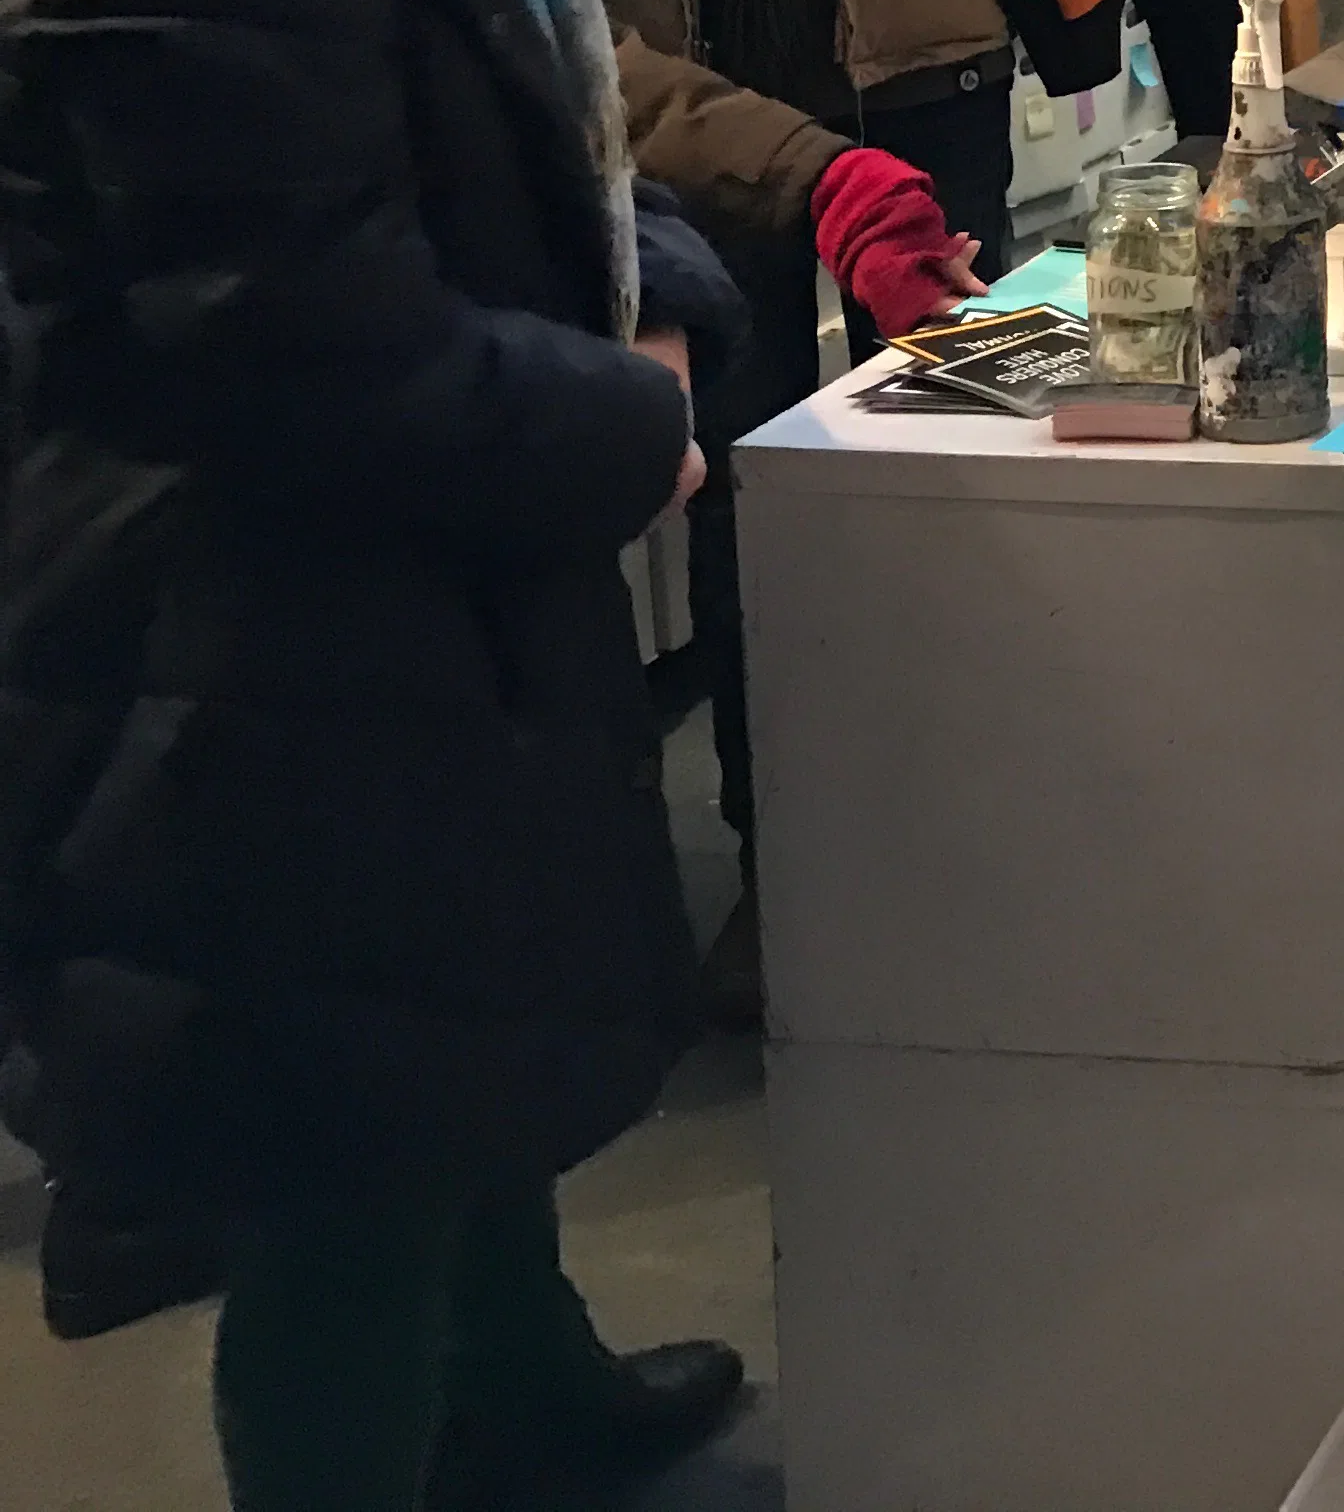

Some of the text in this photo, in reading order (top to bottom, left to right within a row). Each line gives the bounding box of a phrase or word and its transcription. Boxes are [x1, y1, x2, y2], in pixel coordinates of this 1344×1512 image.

[995, 348, 1049, 369] HATE
[995, 347, 1091, 385] CONQUERS
[1039, 363, 1091, 386] LOVE
